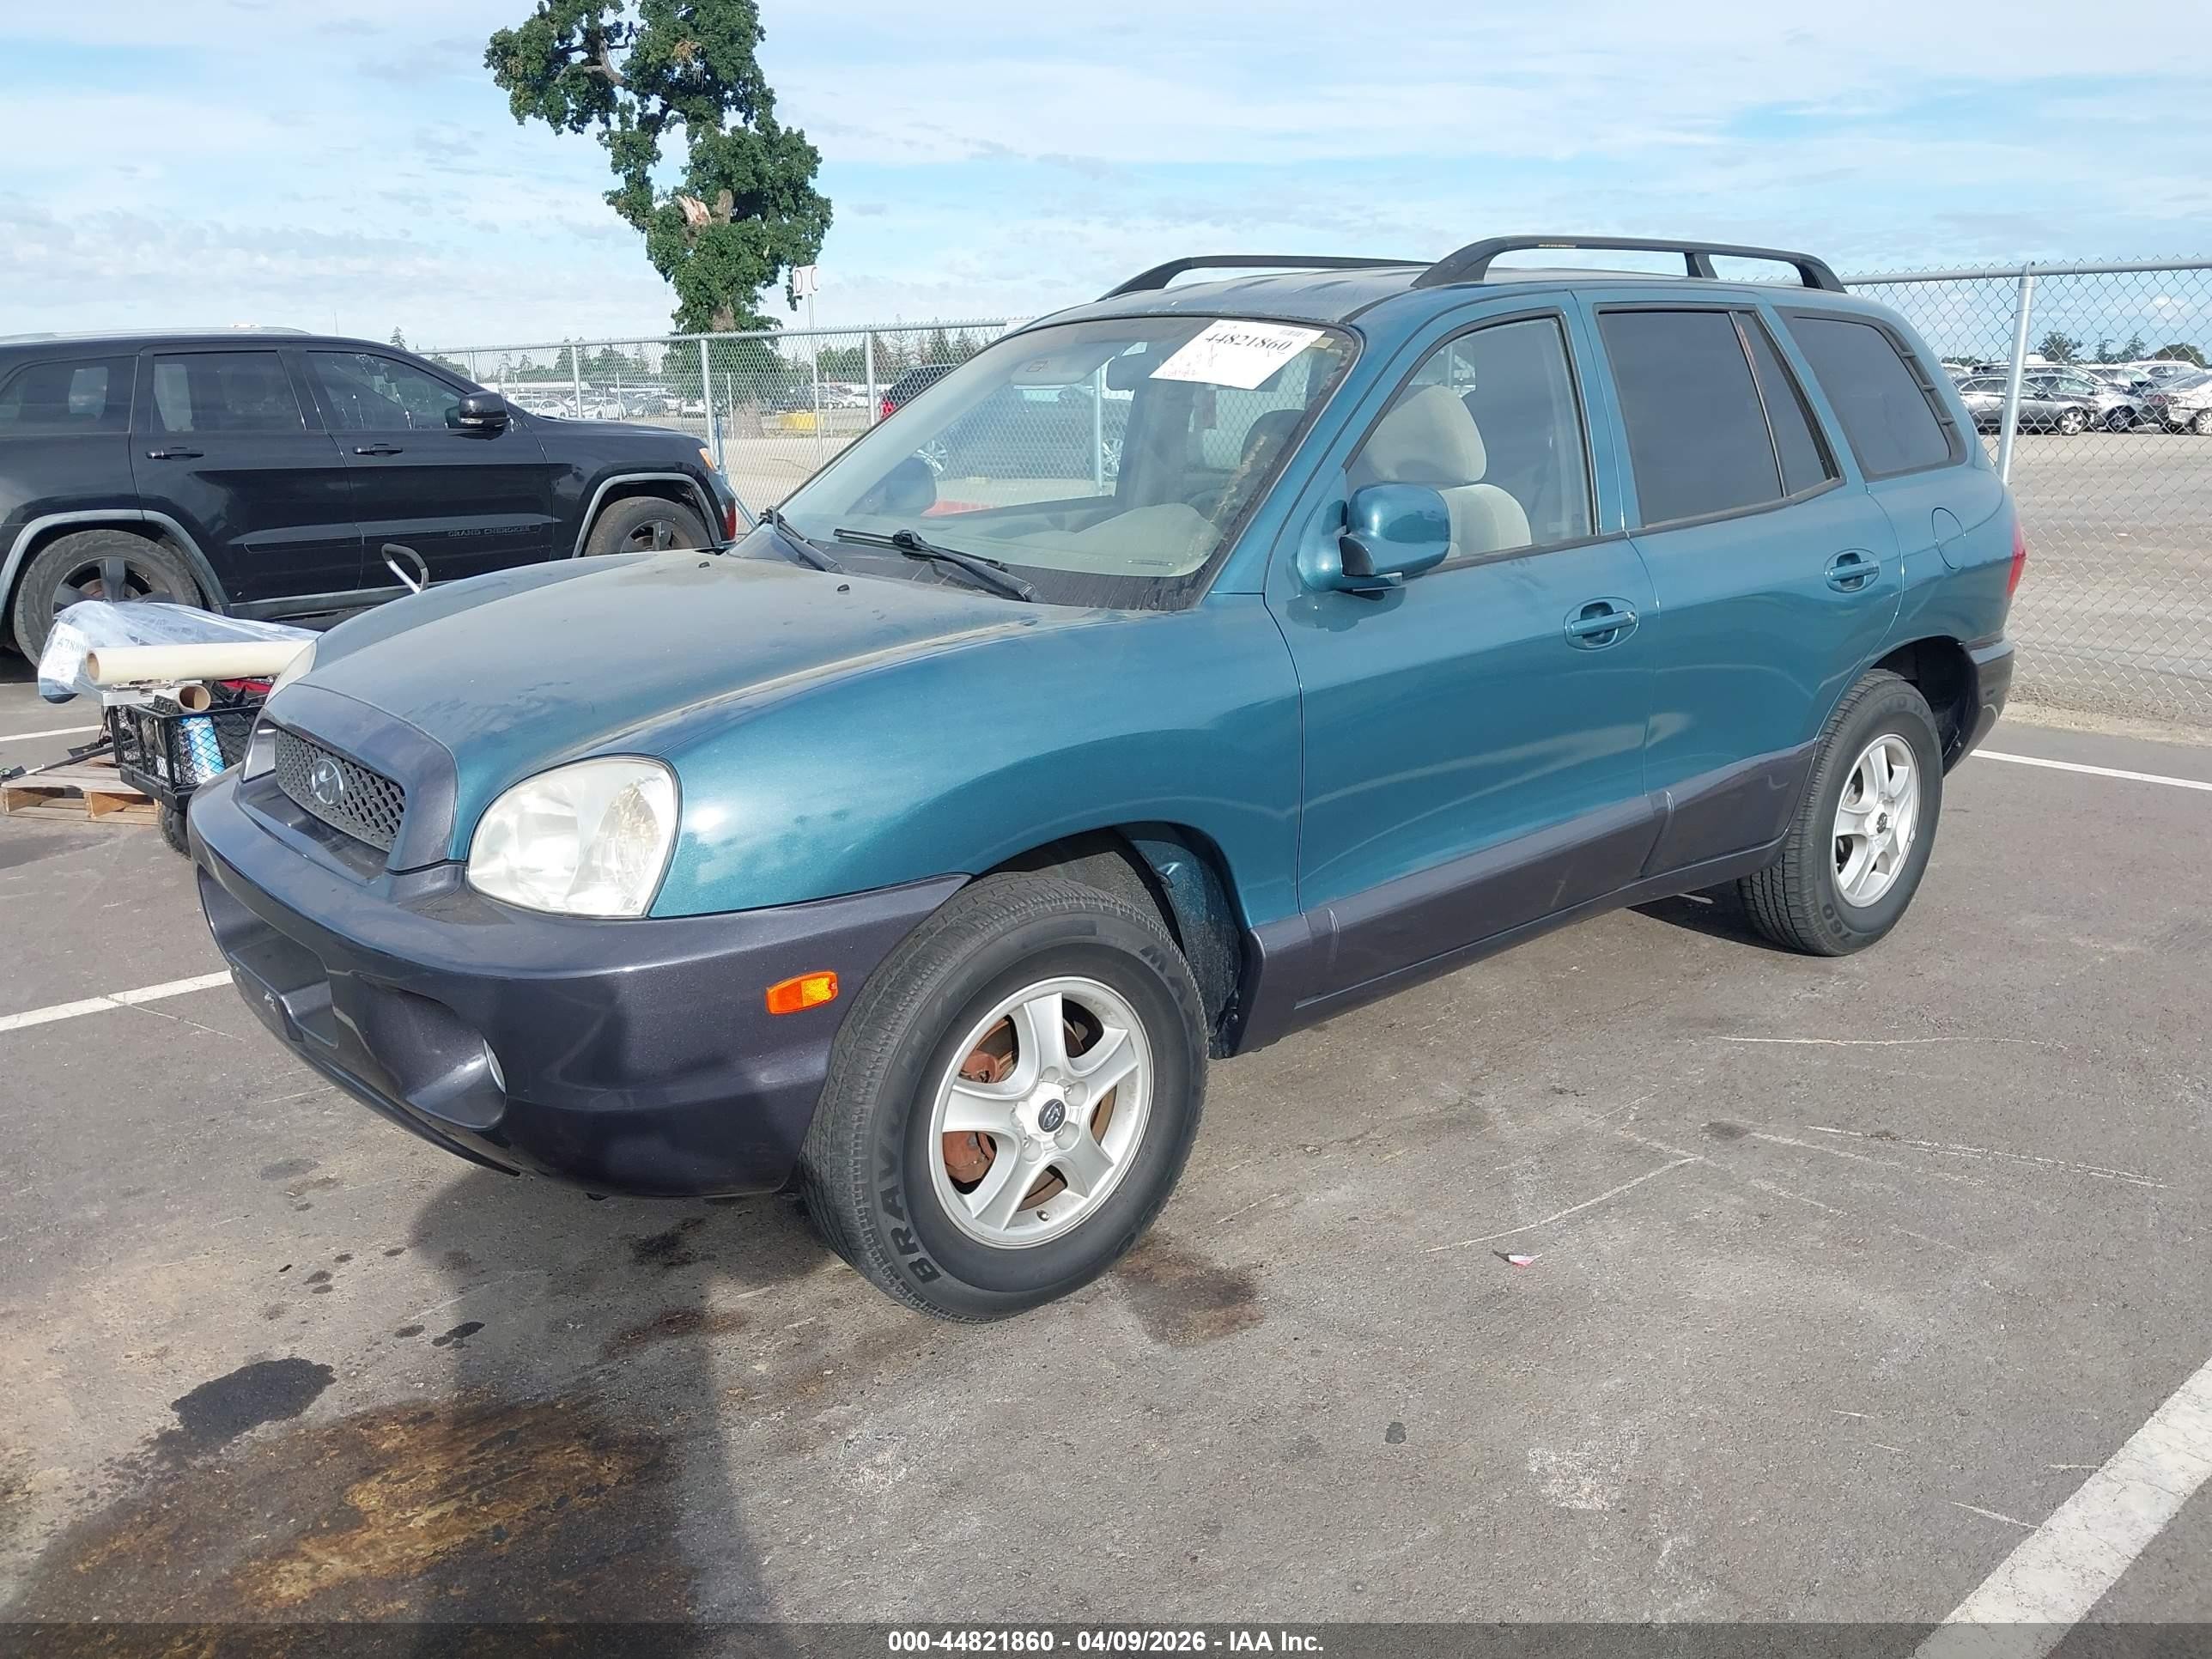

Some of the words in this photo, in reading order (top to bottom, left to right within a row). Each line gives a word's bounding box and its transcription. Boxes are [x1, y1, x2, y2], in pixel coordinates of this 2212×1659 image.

[1204, 332, 1293, 351] 44821860
[447, 528, 482, 538] GRAND
[483, 525, 531, 536] CHEROKEE
